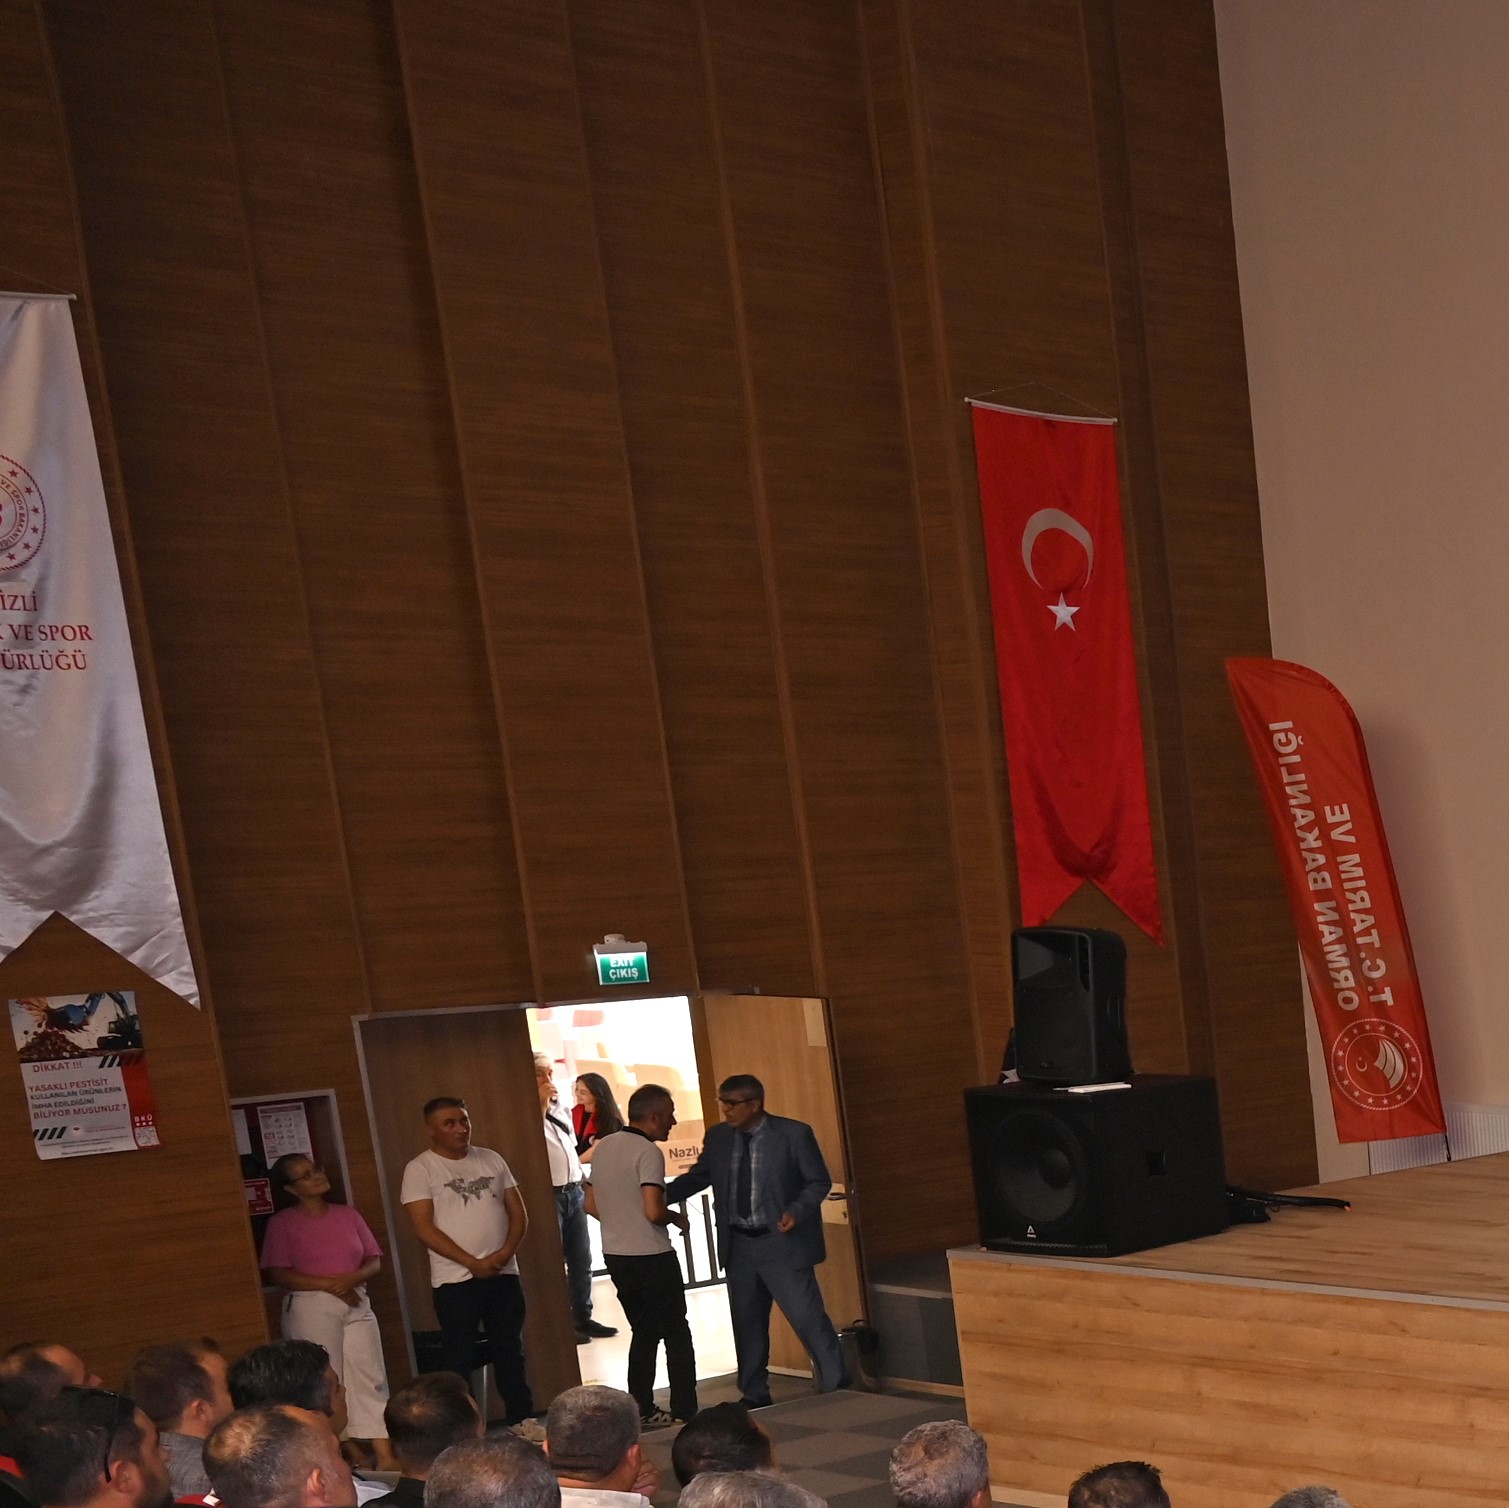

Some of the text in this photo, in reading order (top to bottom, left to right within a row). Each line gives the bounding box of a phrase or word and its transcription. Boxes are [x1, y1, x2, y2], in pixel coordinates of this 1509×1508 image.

[8, 624, 33, 641] VE
[38, 624, 94, 641] SPOR
[610, 957, 634, 967] EXIT
[609, 968, 639, 981] ÇIKIŞ
[32, 1062, 70, 1073] DİKKAT
[29, 1083, 68, 1092] YASAKLI
[33, 1109, 71, 1119] BİLİYOR
[73, 1104, 120, 1115] MUSUNUZ
